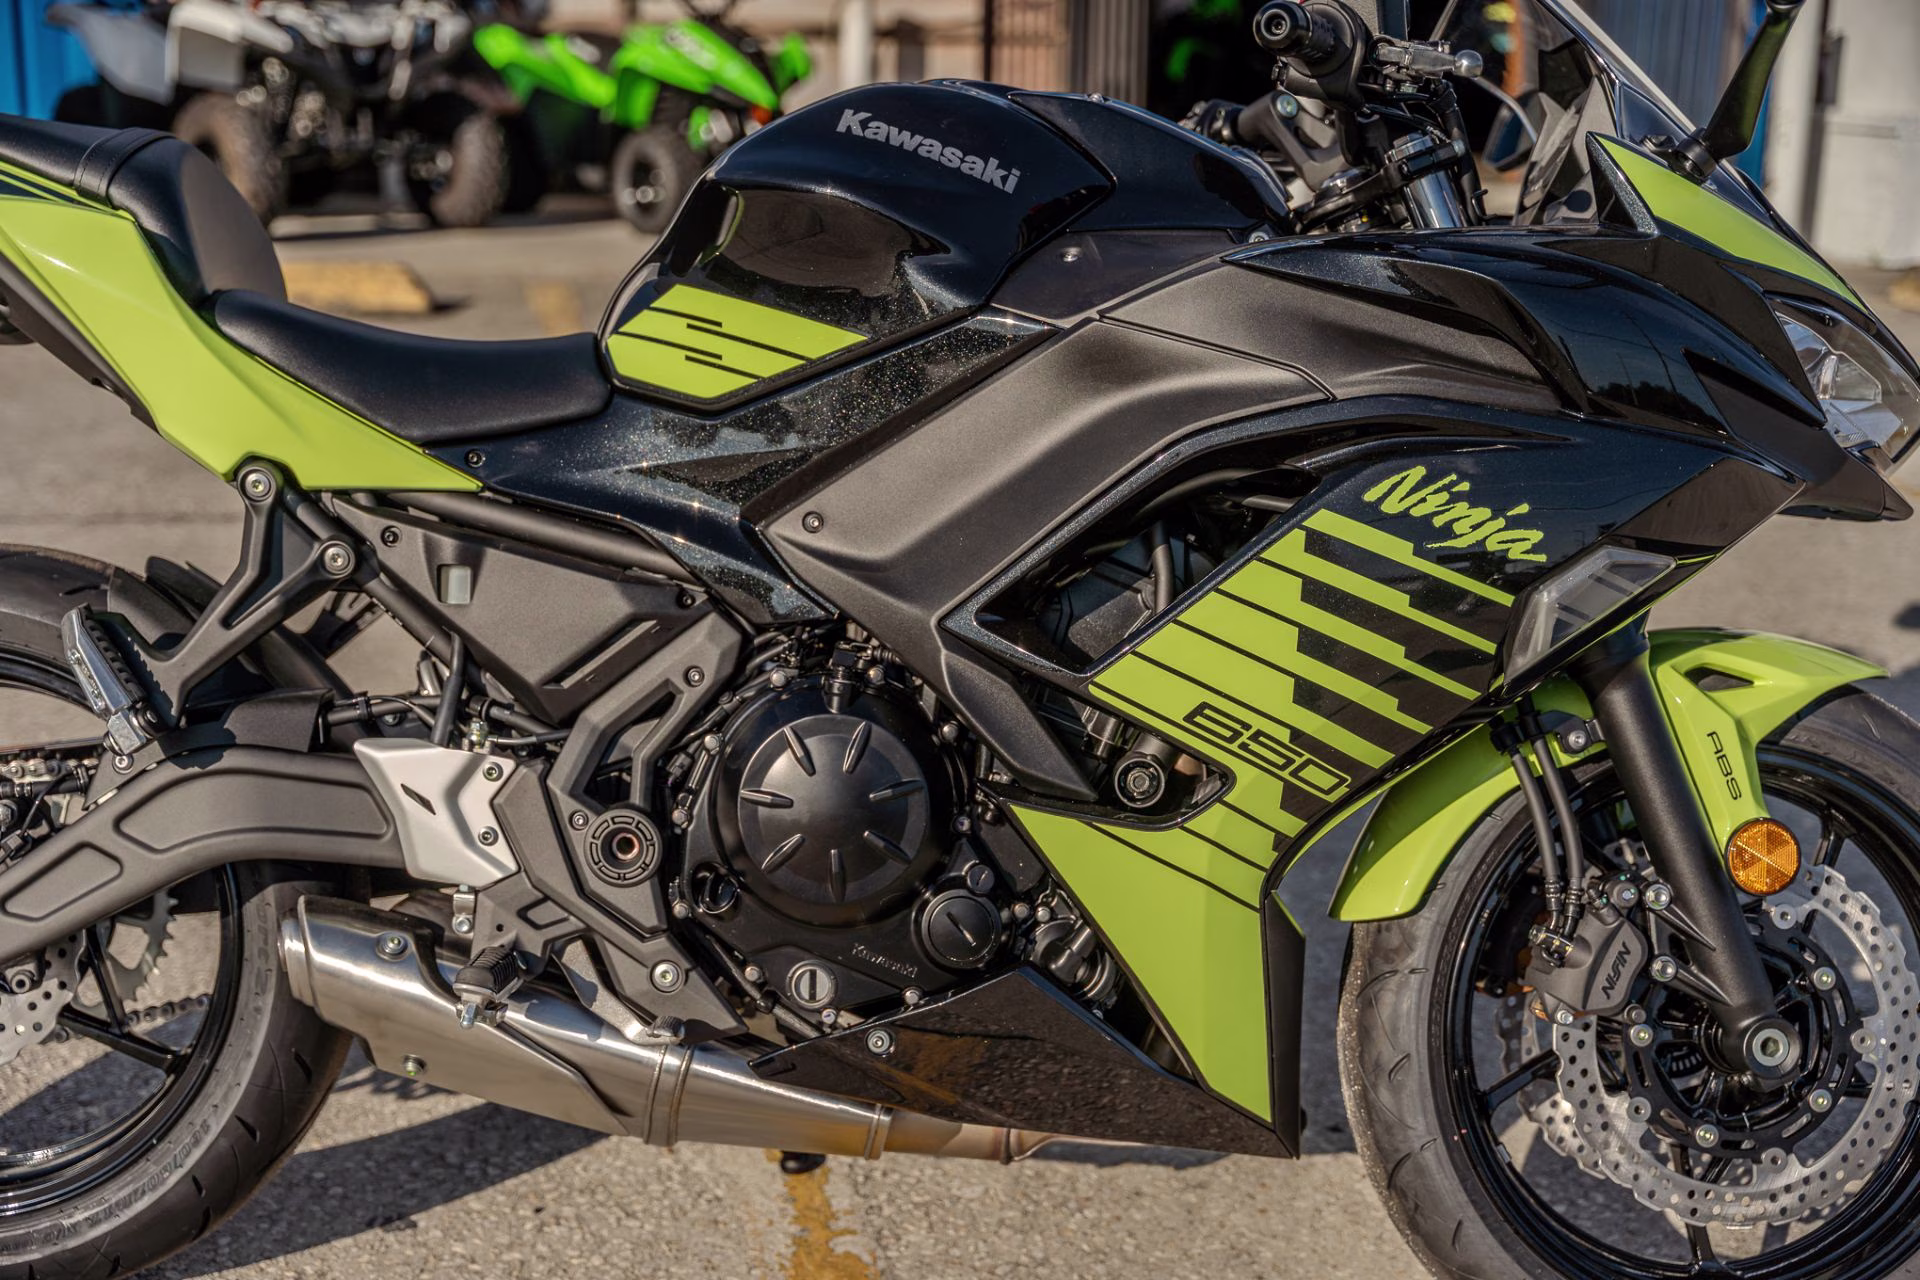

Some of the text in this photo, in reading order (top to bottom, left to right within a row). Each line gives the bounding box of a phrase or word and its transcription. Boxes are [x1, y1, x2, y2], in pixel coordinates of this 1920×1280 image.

[836, 108, 1021, 194] Kawasaki
[1362, 465, 1547, 563] Ninja
[1182, 701, 1350, 795] 650
[1706, 730, 1742, 801] ABS
[852, 942, 918, 978] Kawasaki
